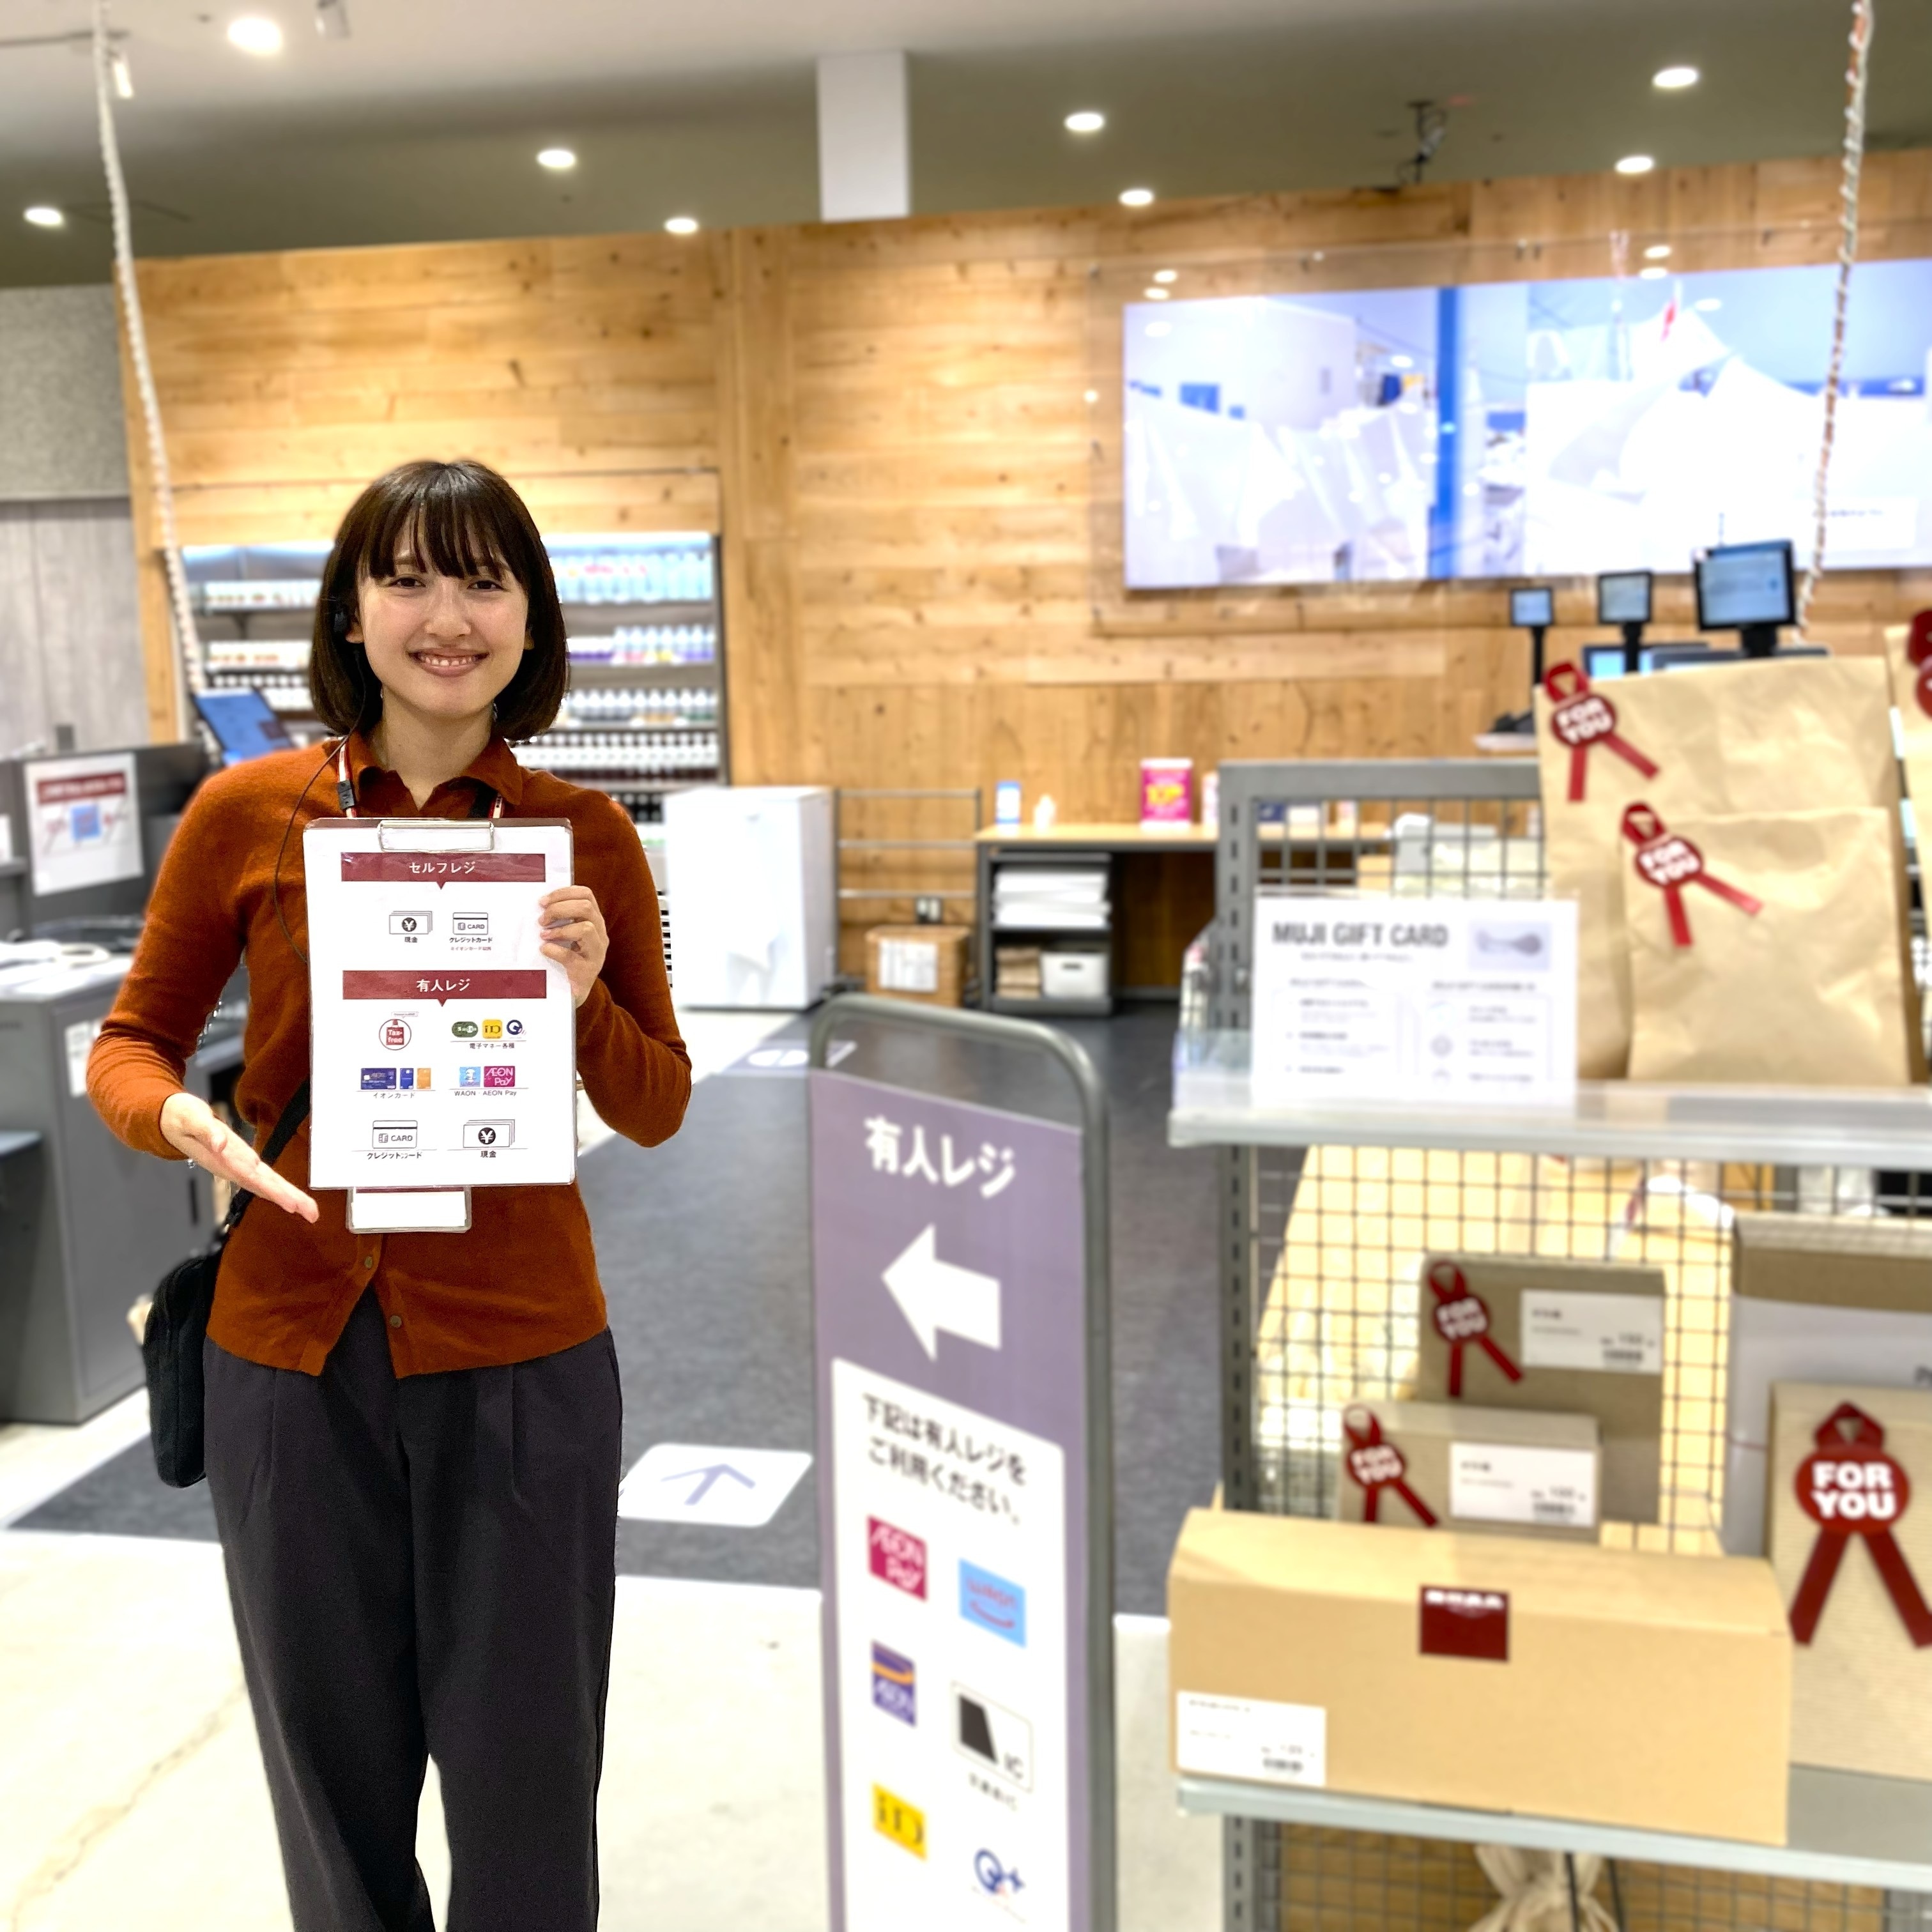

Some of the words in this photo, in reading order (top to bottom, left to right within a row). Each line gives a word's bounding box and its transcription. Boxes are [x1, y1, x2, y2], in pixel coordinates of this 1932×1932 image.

[1556, 697, 1605, 726] FOR
[1561, 714, 1613, 743] YOU
[1639, 839, 1687, 867] FOR
[409, 861, 475, 874] セルフレジ
[1649, 854, 1700, 884] YOU
[1272, 921, 1327, 945] MUJI
[1333, 923, 1384, 946] GIFT
[1390, 924, 1448, 947] CARD
[416, 979, 470, 992] 有人レジ
[864, 1115, 1015, 1199] 有人レジ
[1437, 1297, 1479, 1321] FOR
[1441, 1314, 1487, 1340] YOU
[862, 1392, 1027, 1486] 下記は有人レジを
[1351, 1445, 1395, 1469] FOR
[868, 1436, 1020, 1525] ご利用ください。
[1355, 1458, 1402, 1485] YOU
[1812, 1462, 1892, 1489] FOR
[1811, 1491, 1896, 1519] YOU
